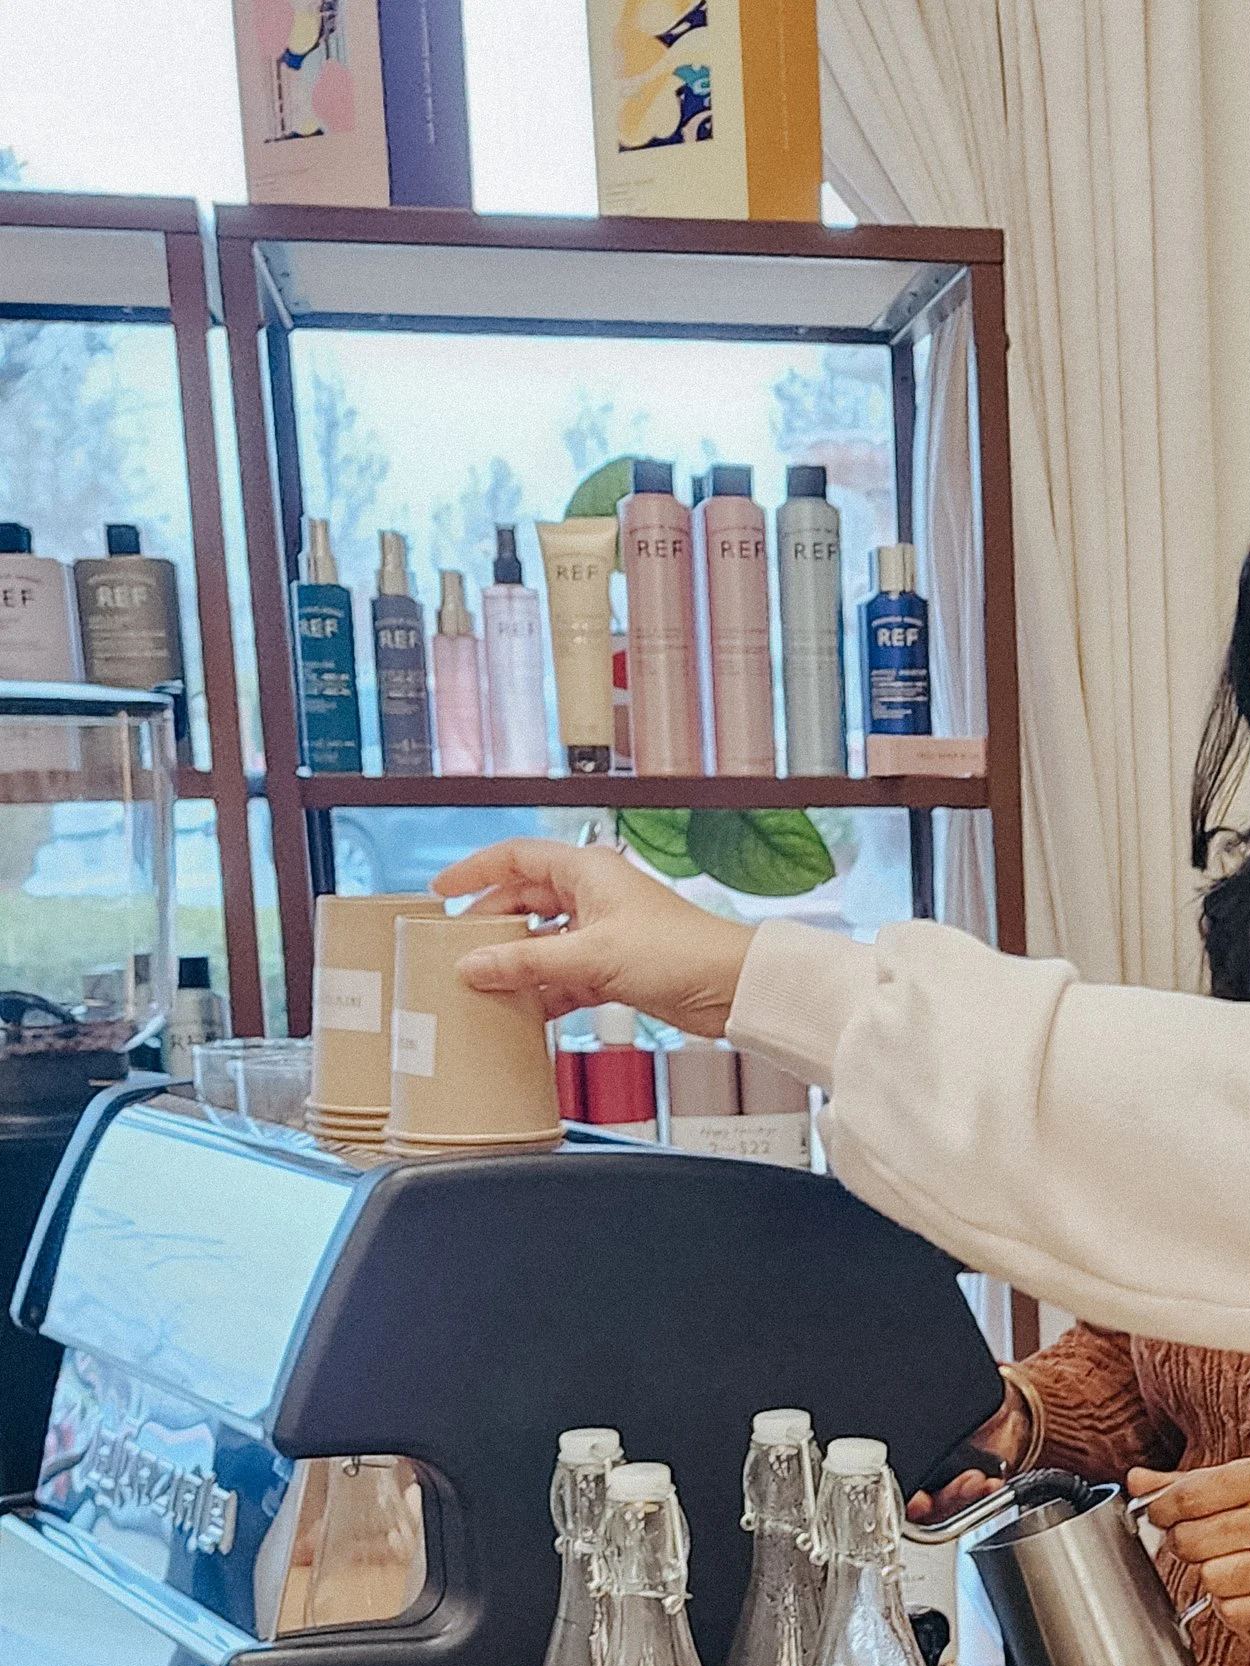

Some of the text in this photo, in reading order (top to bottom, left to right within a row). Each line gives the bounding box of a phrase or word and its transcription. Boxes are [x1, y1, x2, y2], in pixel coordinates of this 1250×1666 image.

[636, 539, 684, 559] REF
[720, 540, 765, 559] REF
[794, 542, 838, 560] REF
[556, 563, 600, 582] REF
[2, 588, 34, 608] EF
[96, 585, 149, 608] REF
[379, 629, 418, 650] REF
[876, 627, 920, 648] REF
